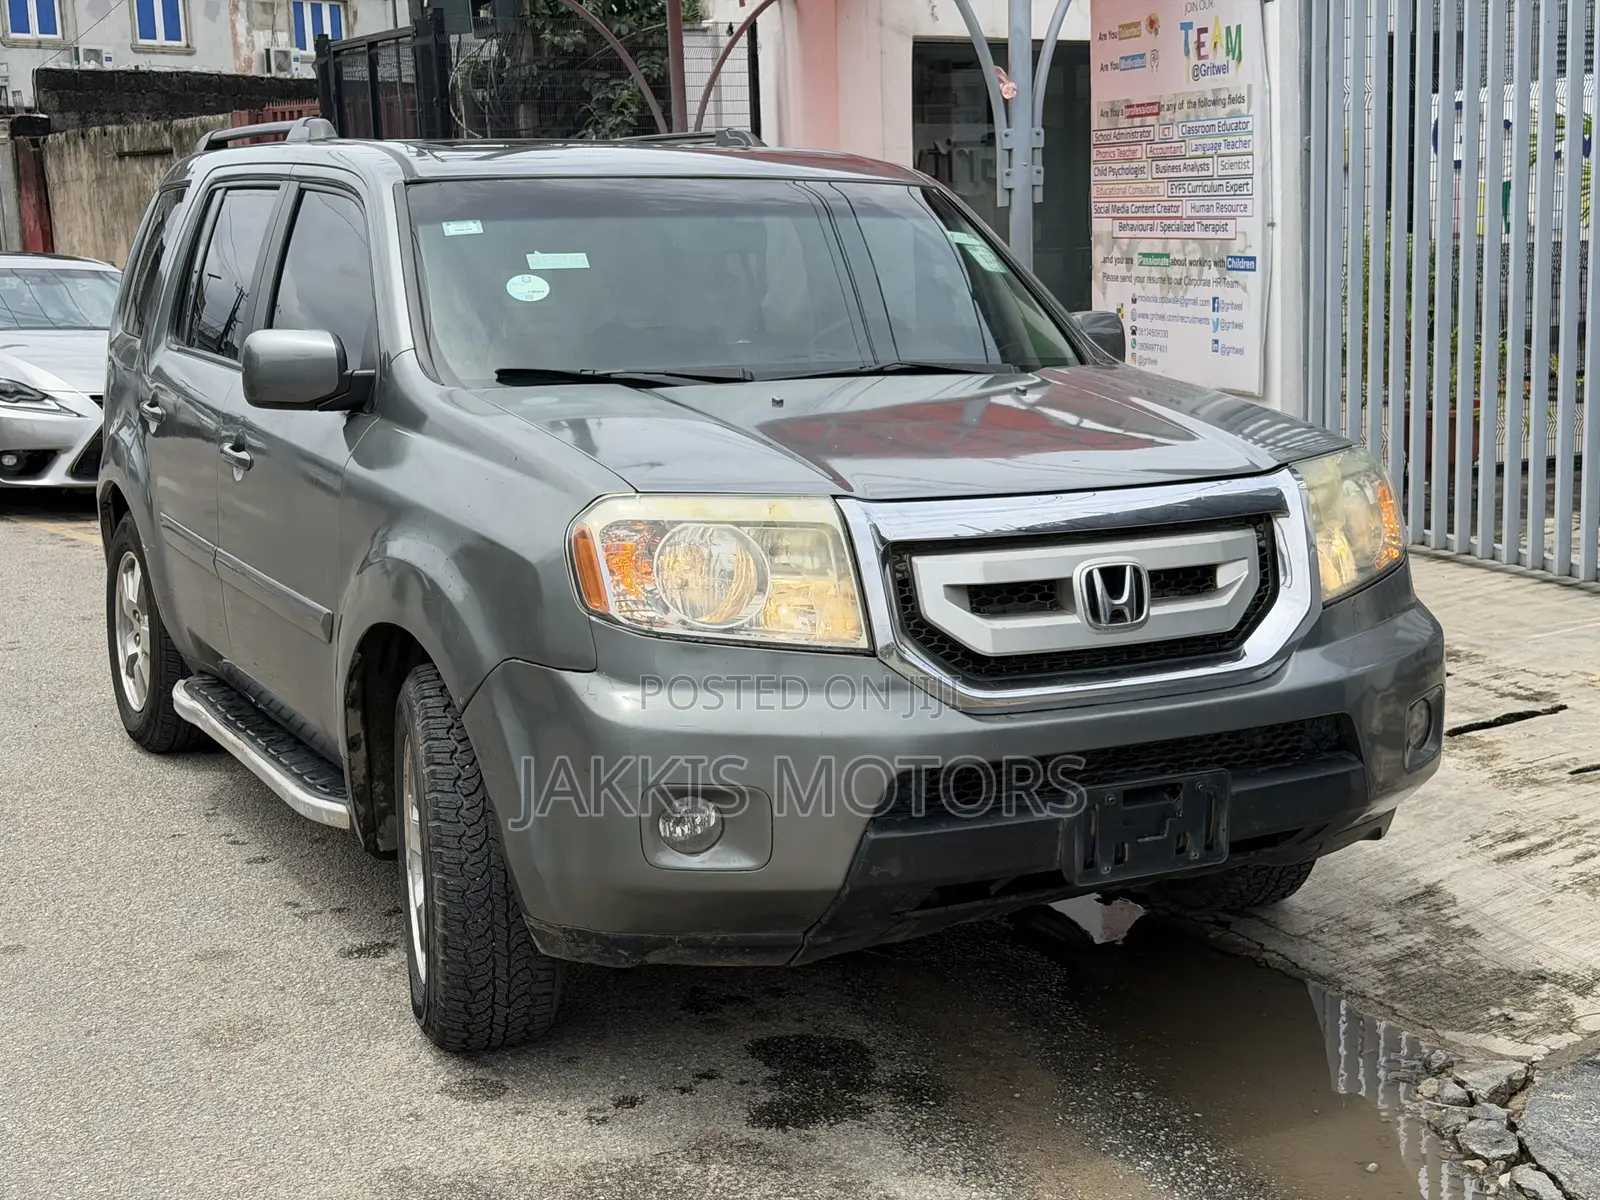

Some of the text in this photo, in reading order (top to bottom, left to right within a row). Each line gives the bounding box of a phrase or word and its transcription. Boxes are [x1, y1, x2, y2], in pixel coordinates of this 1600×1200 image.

[1184, 0, 1214, 16] JOIN OUR
[1098, 32, 1107, 42] Are
[1108, 30, 1117, 39] You
[1180, 15, 1242, 62] TEAM
[1100, 62, 1109, 72] Are
[1109, 61, 1119, 70] You
[1192, 60, 1229, 81] @Gritwel
[1100, 109, 1109, 118] Are
[1110, 108, 1119, 117] You
[1125, 103, 1159, 117] professional
[1166, 102, 1176, 114] any
[1178, 101, 1184, 110] of
[1187, 99, 1196, 109] the
[1198, 95, 1226, 109] following
[1228, 94, 1245, 105] fields
[1161, 127, 1171, 137] ICT
[1181, 120, 1250, 135] Classroom Educator
[1095, 128, 1152, 142] School Administrator
[1149, 144, 1183, 155] Accountant
[1191, 138, 1251, 154] Language Teacher
[1096, 147, 1138, 159] Phonics Teacher
[1155, 162, 1210, 175] Business Analysts
[1220, 158, 1250, 171] Scientist
[1094, 165, 1146, 179] Child Psychologist
[1096, 184, 1160, 196] Educational Consultant
[1170, 181, 1250, 195] EYFS Curriculum Expert
[1094, 203, 1180, 214] Social Media Content Creator
[1190, 203, 1248, 213] Human Resource
[1118, 222, 1155, 232] Behavioural
[1159, 222, 1195, 234] Specialized
[1197, 222, 1228, 234] Therapist
[1114, 258, 1124, 266] you
[1138, 254, 1170, 266] Passionate
[1170, 256, 1187, 267] about
[1188, 257, 1211, 270] working
[1213, 257, 1226, 268] with
[1227, 257, 1255, 270] Children
[1102, 272, 1119, 282] Please
[1120, 273, 1132, 283] send
[1134, 275, 1145, 285] your
[1147, 276, 1166, 284] resume
[1173, 277, 1182, 285] our
[1184, 277, 1211, 288] Corporate
[1212, 279, 1222, 288] HR
[1223, 279, 1238, 289] Team
